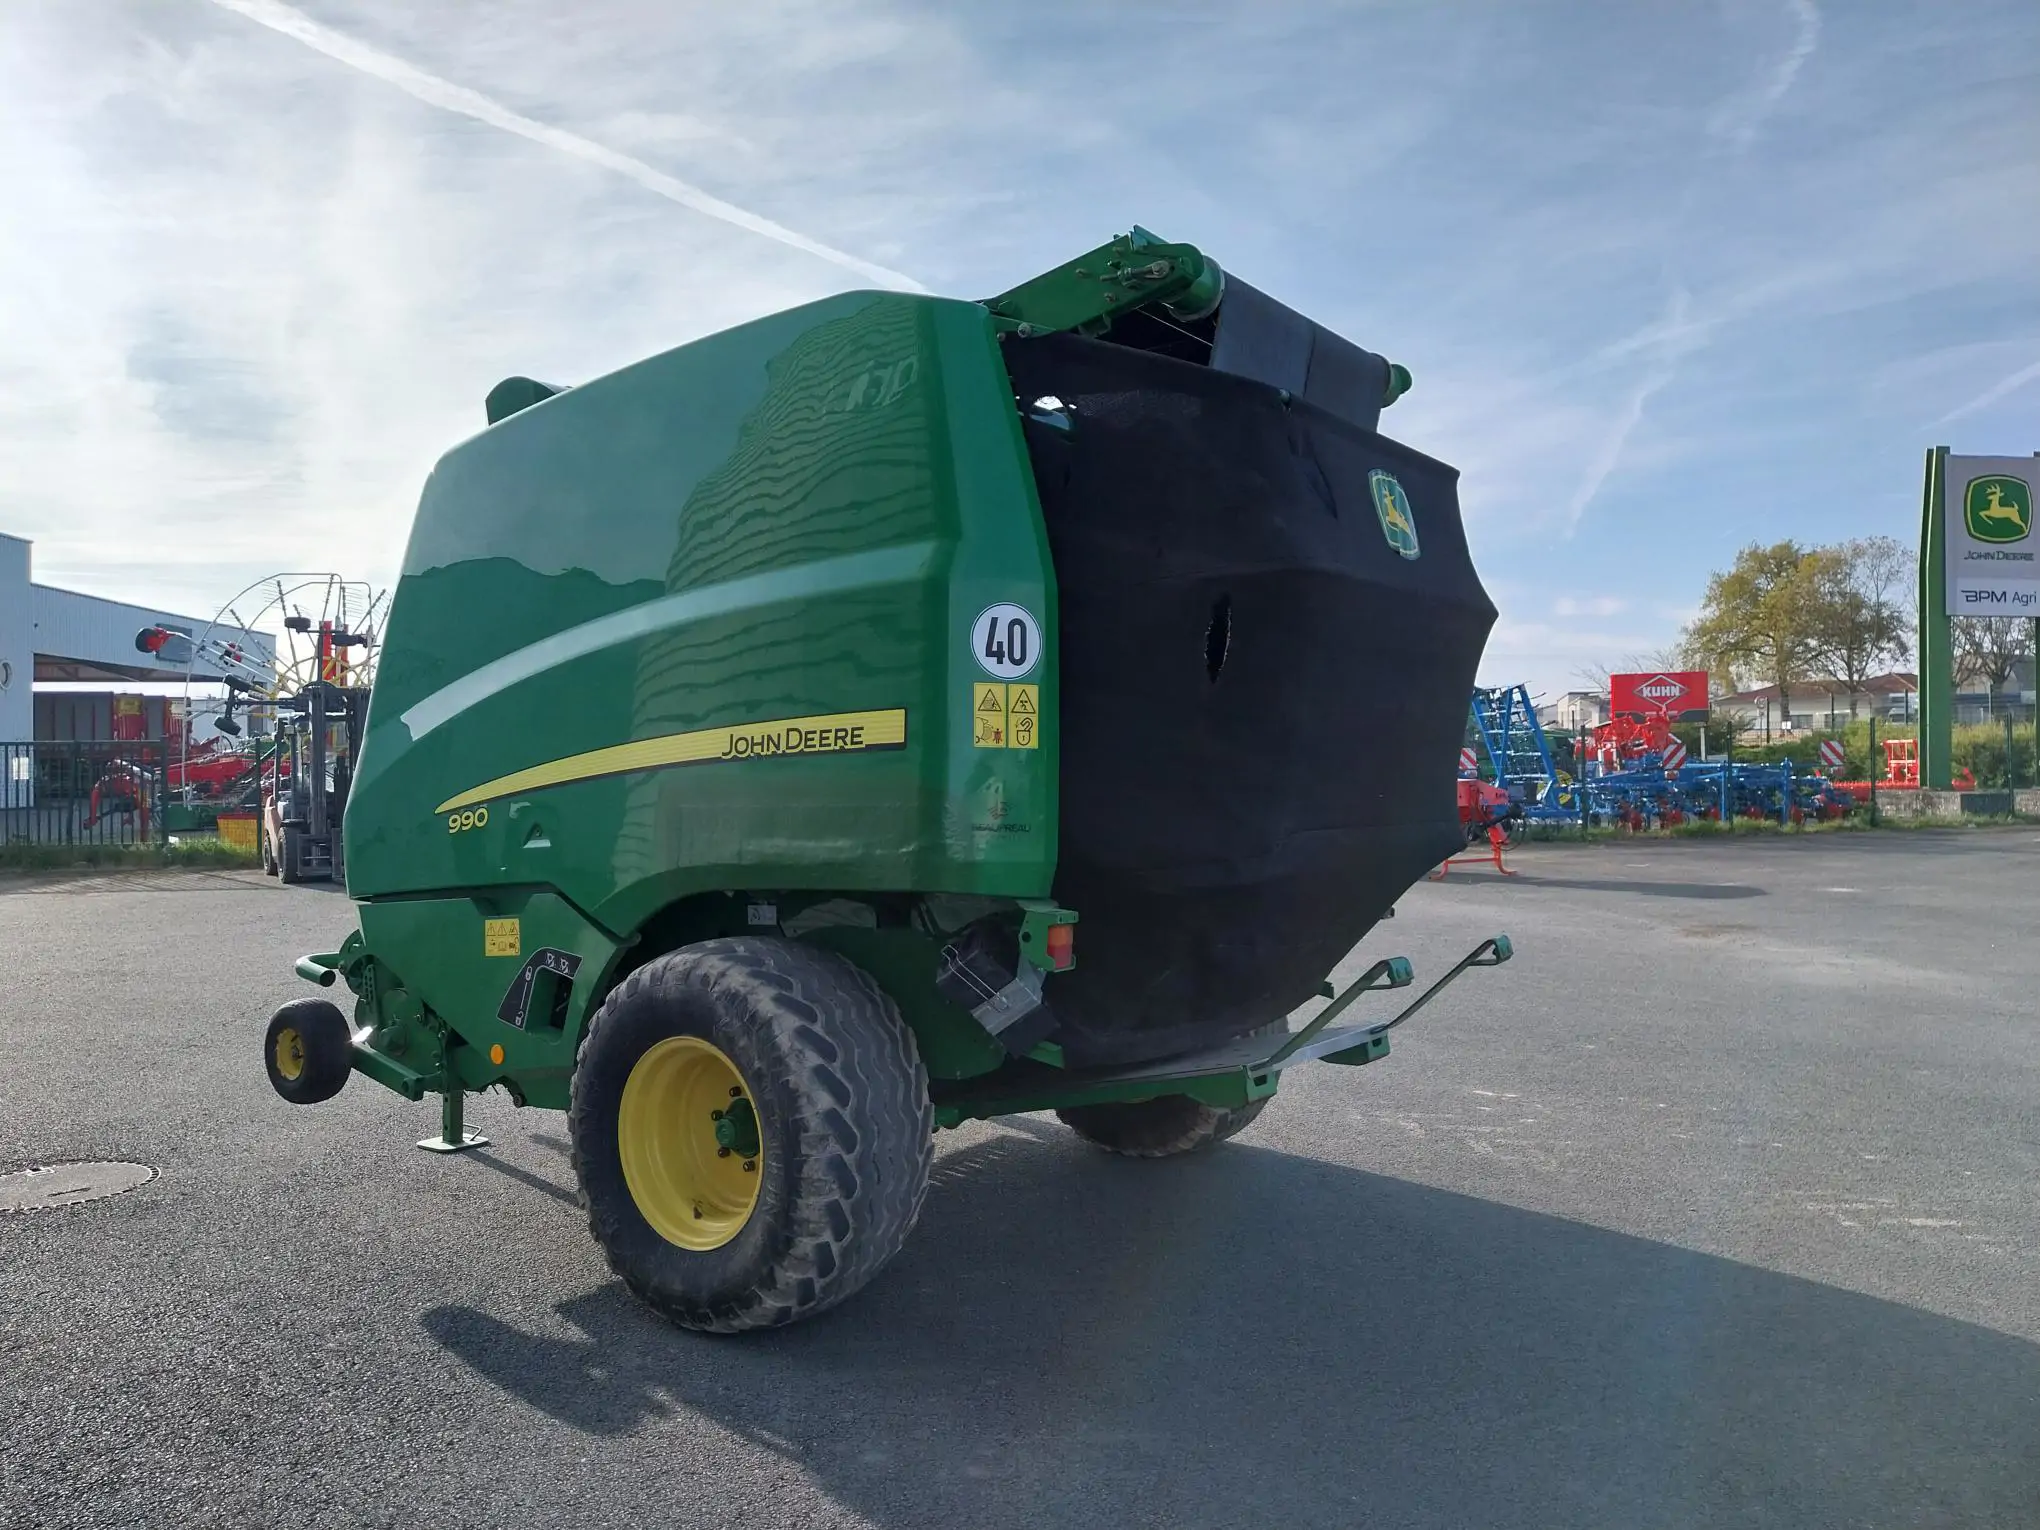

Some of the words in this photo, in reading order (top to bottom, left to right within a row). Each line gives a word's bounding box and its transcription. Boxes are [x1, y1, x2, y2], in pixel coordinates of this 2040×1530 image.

[1964, 551, 1995, 560] JOHN
[1996, 551, 2034, 561] DEERE
[1961, 590, 2007, 603] BPM
[2012, 591, 2037, 607] Agri
[985, 617, 1027, 666] 40
[1642, 686, 1680, 697] KUHN
[722, 733, 781, 757] JOHN
[786, 727, 865, 750] DEERE
[448, 807, 489, 834] 990
